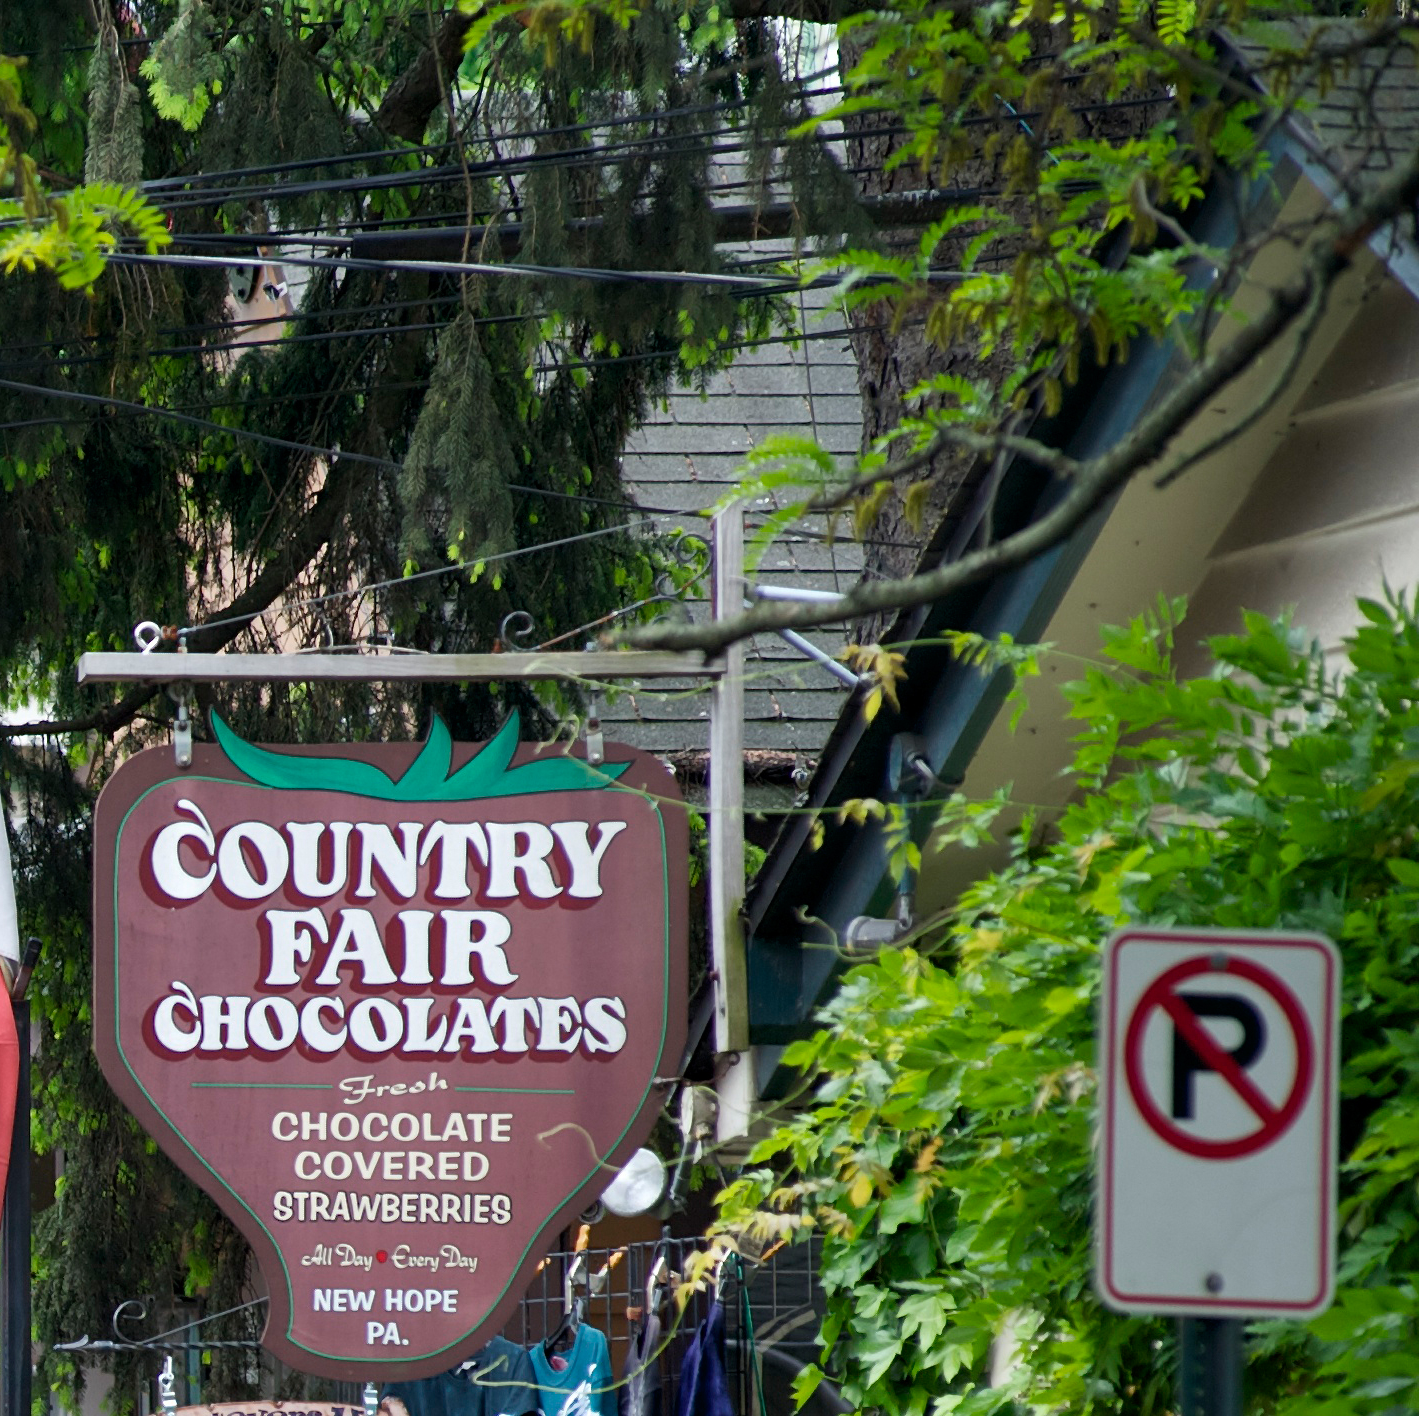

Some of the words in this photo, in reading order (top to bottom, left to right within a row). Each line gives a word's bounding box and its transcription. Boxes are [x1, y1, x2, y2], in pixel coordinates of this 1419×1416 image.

[151, 799, 627, 900] COUNTRY
[264, 908, 520, 987] FAIR
[153, 981, 628, 1054] CHOCOLATES
[339, 1071, 449, 1105] Fresh
[271, 1111, 513, 1143] CHOCOLATE
[294, 1151, 490, 1182] COVERED
[273, 1191, 512, 1225] STRAWBERRIES
[301, 1244, 332, 1267] All
[335, 1243, 373, 1271] Day
[391, 1244, 439, 1273] Every
[440, 1244, 478, 1273] Day
[313, 1288, 376, 1313] NEW
[385, 1289, 459, 1313] HOPE
[366, 1321, 410, 1346] PA.
